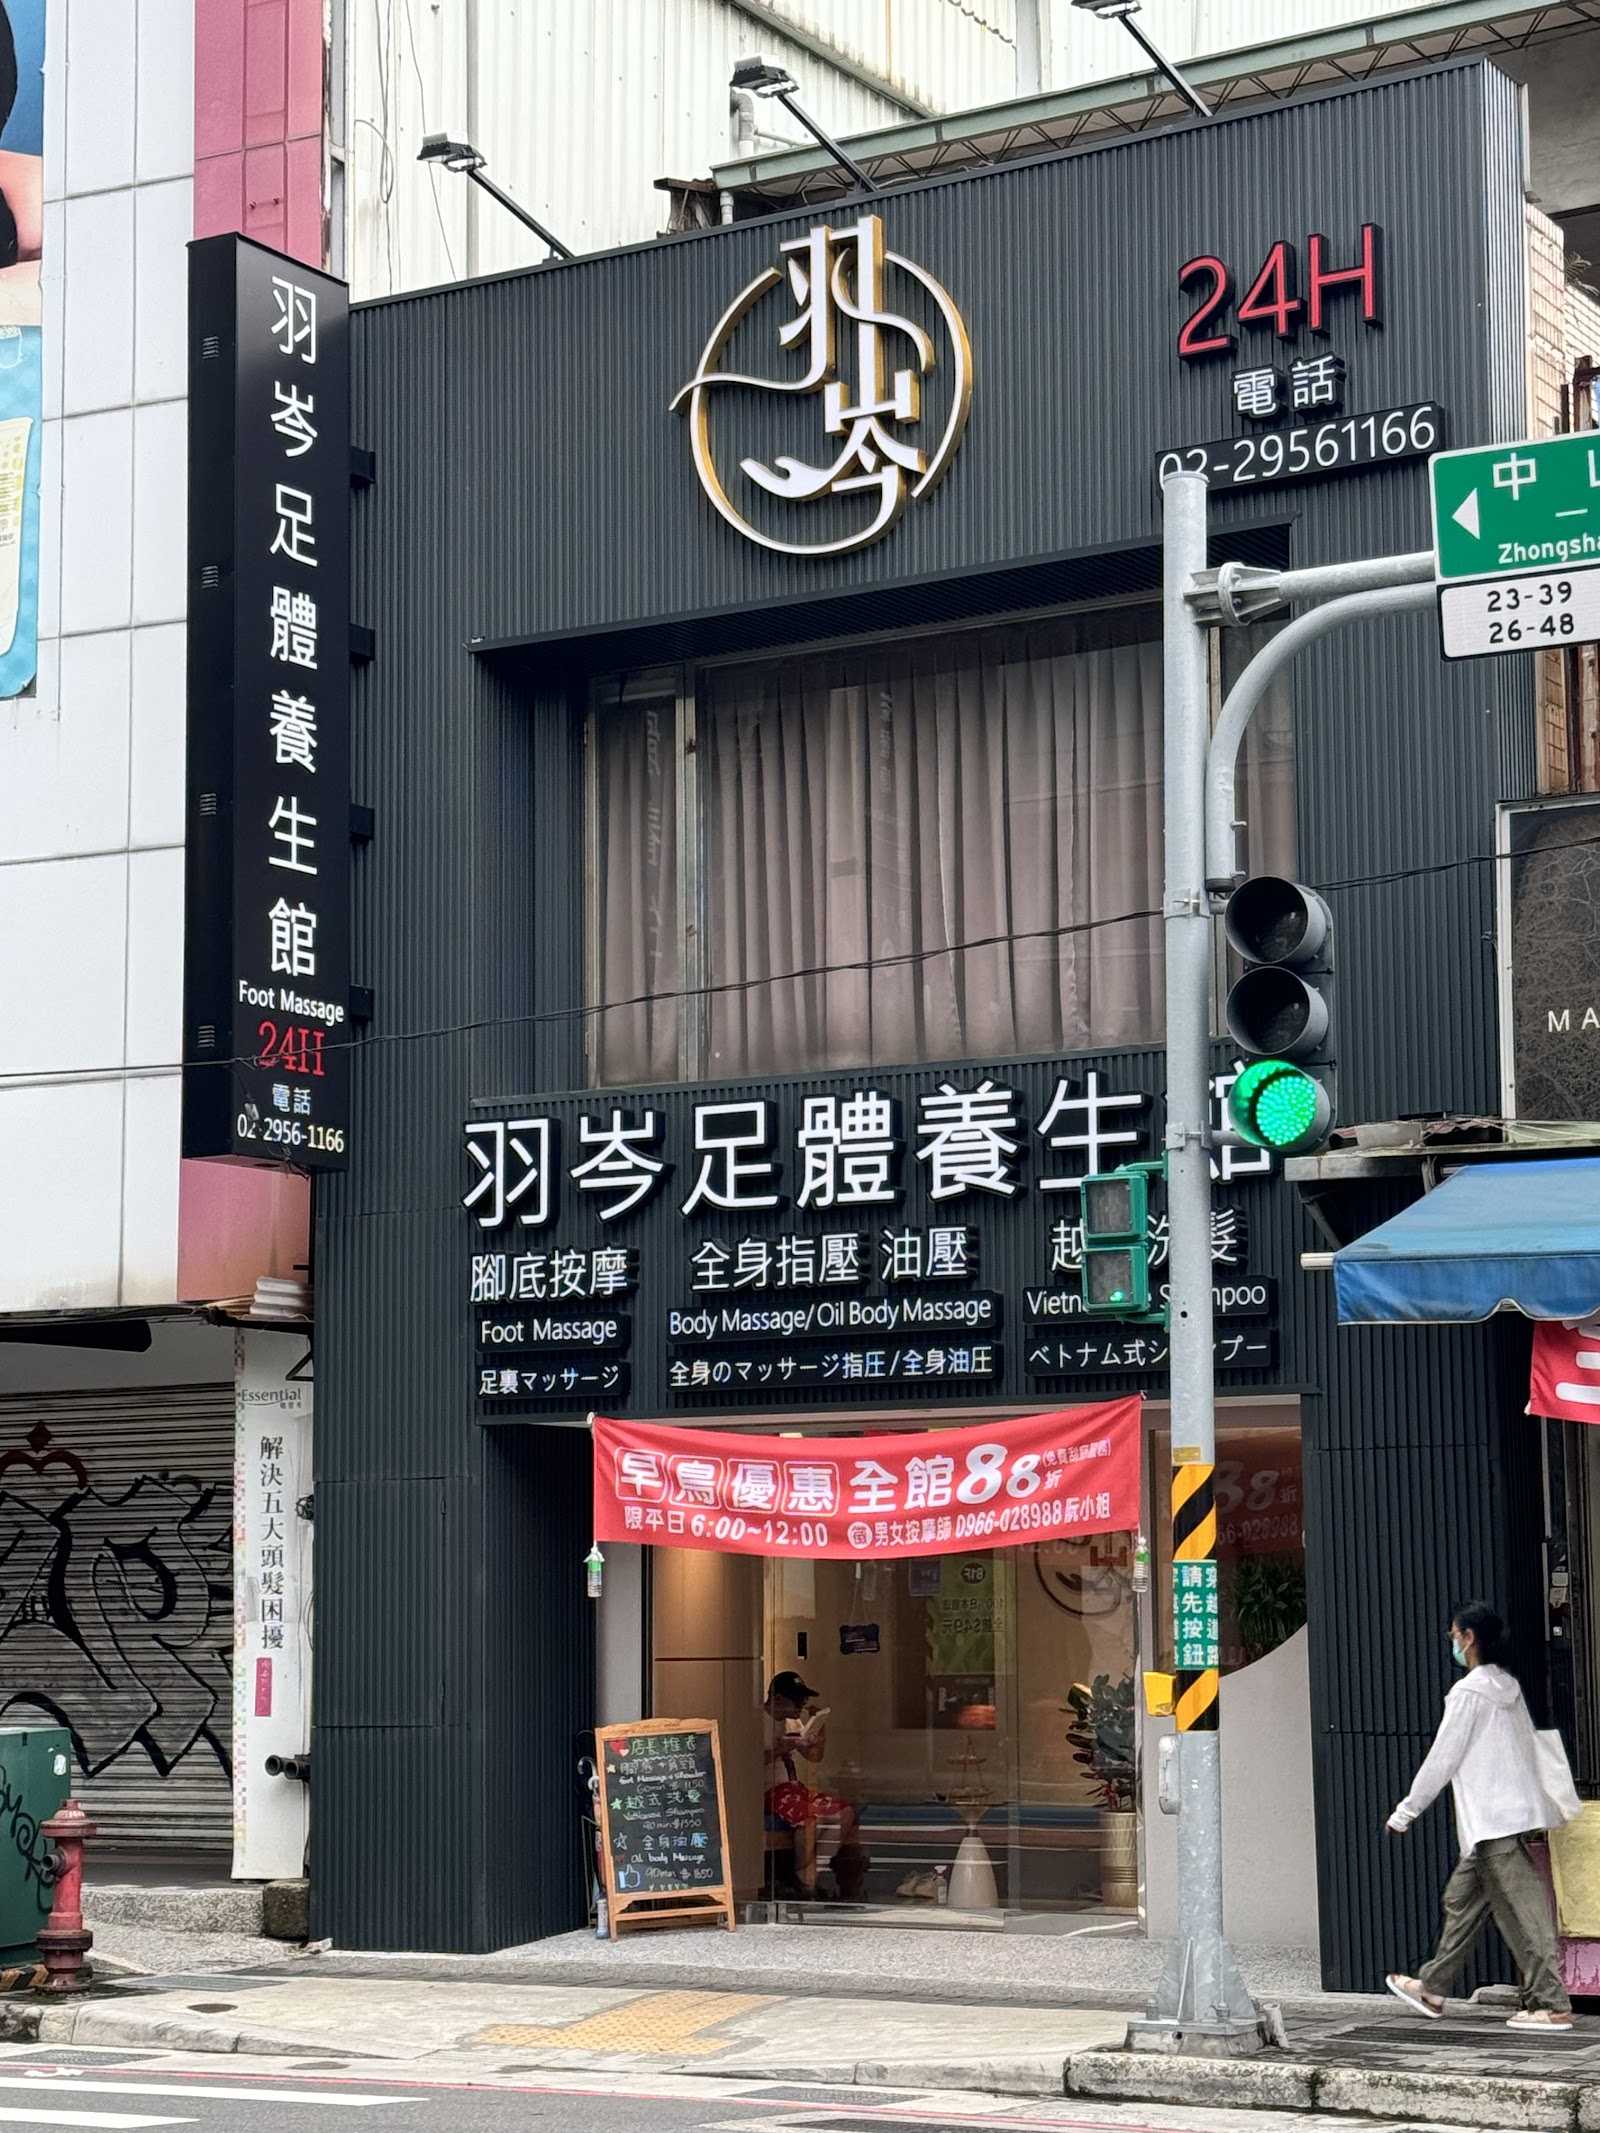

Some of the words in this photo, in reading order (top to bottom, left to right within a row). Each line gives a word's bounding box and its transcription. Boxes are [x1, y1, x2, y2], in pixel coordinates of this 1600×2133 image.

[1178, 223, 1377, 358] 24H
[1233, 354, 1336, 416] 電話
[1498, 532, 1600, 565] Zhongsh
[1487, 581, 1572, 612] 23-39
[268, 276, 318, 977] 羽岑足體養生館
[1489, 613, 1575, 643] 26-48
[239, 979, 275, 1009] Foot
[280, 988, 344, 1026] Massage
[272, 1083, 311, 1116] 電話
[470, 1247, 628, 1302] 腳底按摩
[691, 1233, 860, 1291] 全身指壓
[881, 1226, 968, 1280] 油壓
[481, 1320, 524, 1343] Foot
[533, 1316, 617, 1345] Massage
[670, 1309, 718, 1339] Body
[849, 1297, 898, 1330] Body
[903, 1296, 991, 1328] Massage
[1029, 1335, 1267, 1369] ベトナム式シプー
[241, 1387, 301, 1402] Essential
[478, 1364, 619, 1395] 足裏マッサージ
[619, 1450, 837, 1512] 早鳥優惠
[955, 1502, 1062, 1540] 0966-028988
[259, 1436, 284, 1650] 解決五大頭髮困擾
[1181, 1566, 1204, 1666] 請先按鈕
